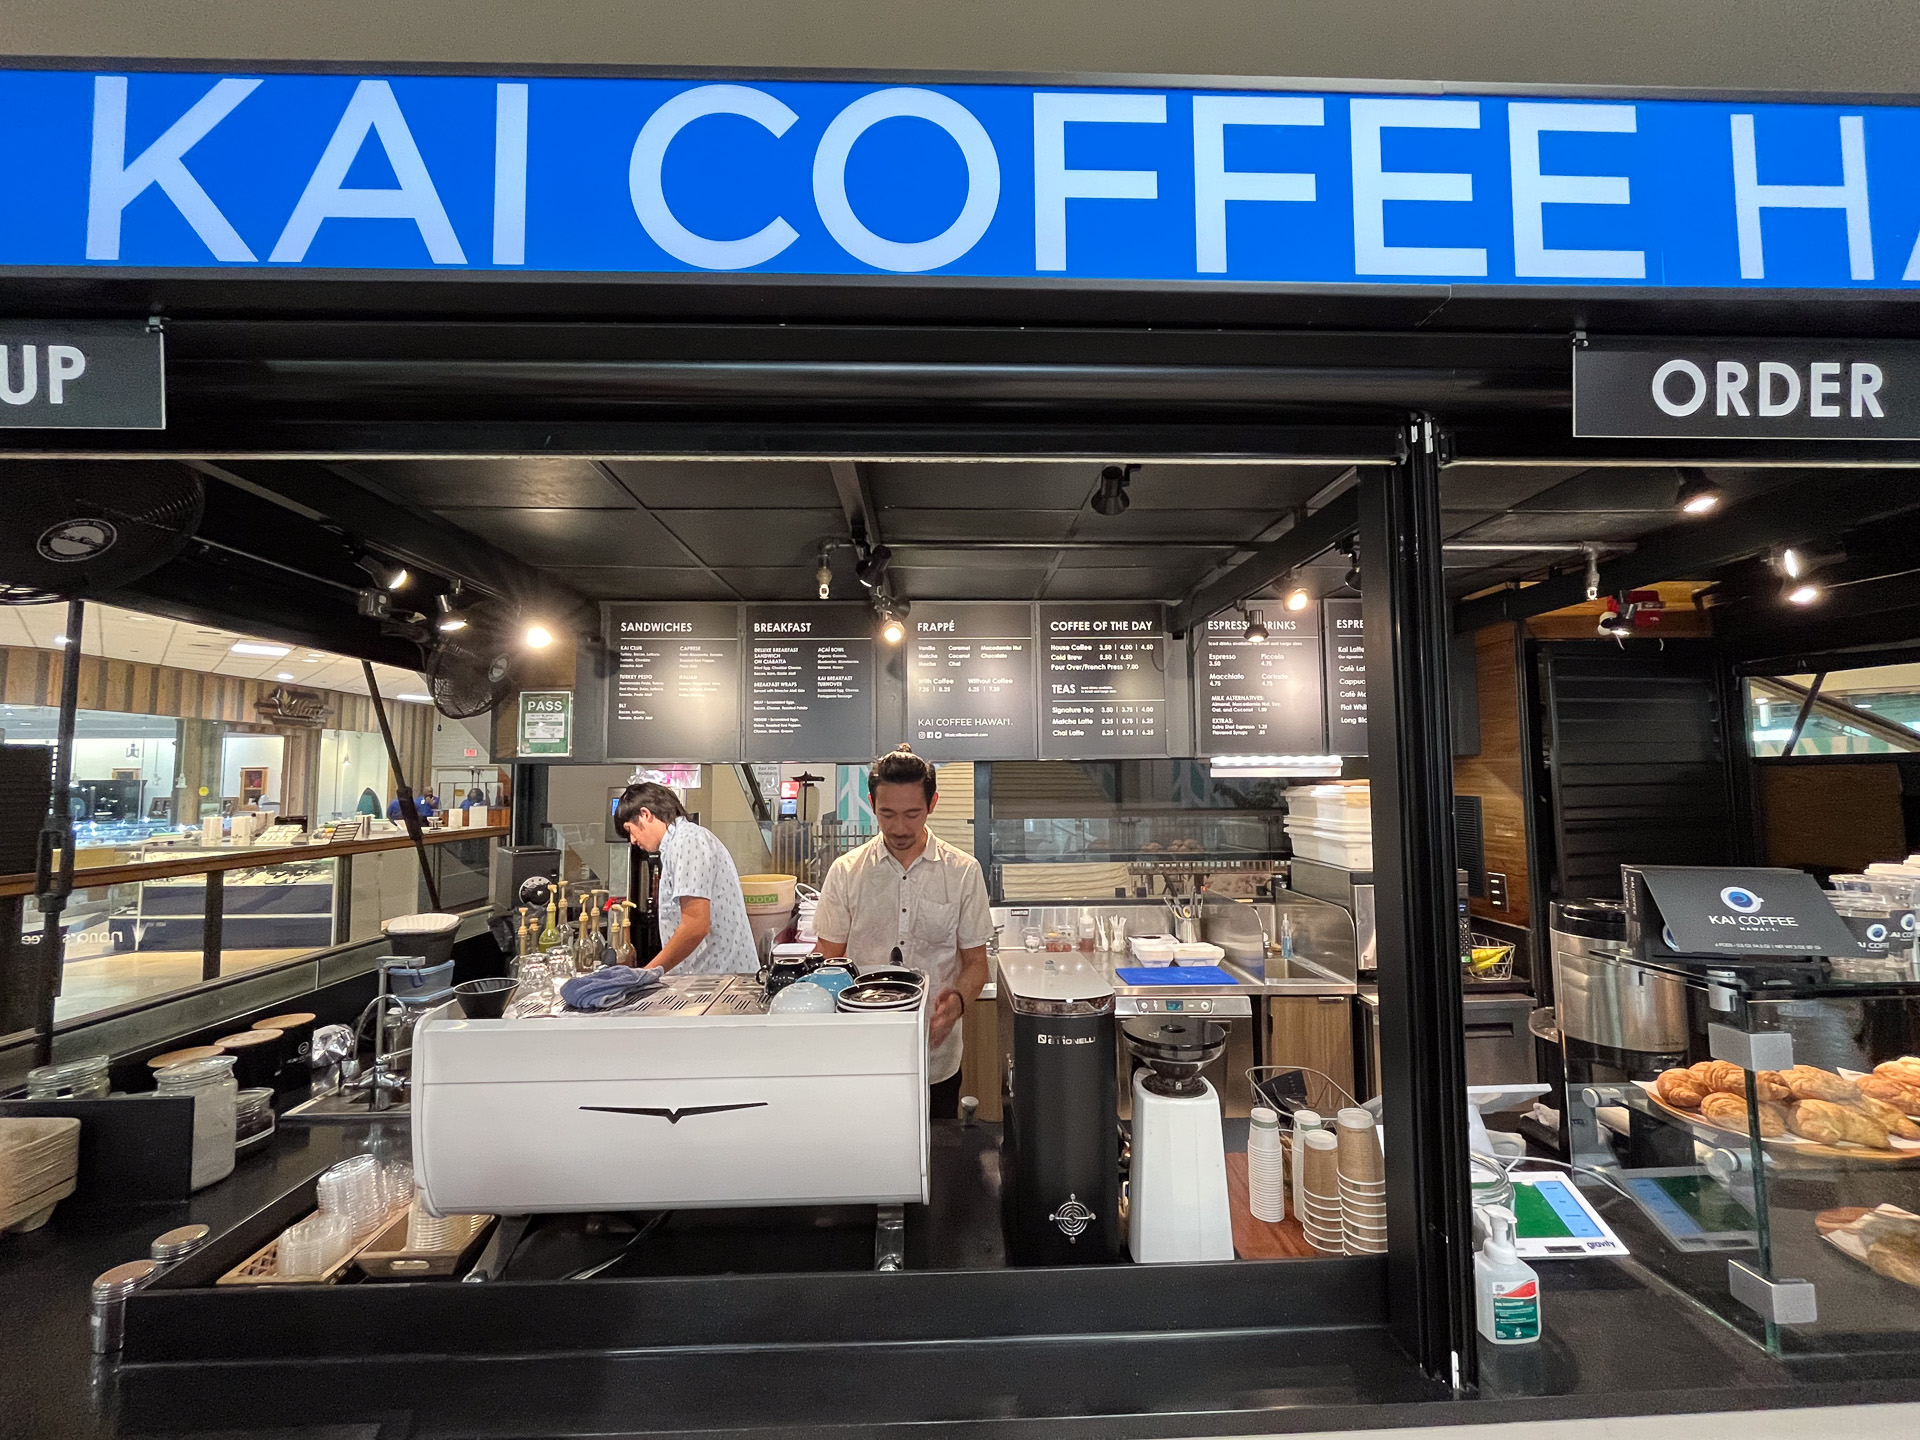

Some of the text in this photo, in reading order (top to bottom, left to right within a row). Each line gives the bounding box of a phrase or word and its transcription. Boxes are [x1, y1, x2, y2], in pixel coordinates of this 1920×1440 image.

[86, 75, 1920, 281] KAI COFFEE H
[0, 344, 86, 405] UP
[1651, 359, 1885, 420] ORDER
[620, 622, 692, 632] SANDWICHES
[754, 623, 811, 632] BREAKFAST
[917, 620, 955, 632] FRAPPÉ
[1050, 621, 1152, 631] COFFEE OF THE DAY
[1052, 685, 1076, 694] TEAS
[528, 701, 562, 711] PASS
[1708, 915, 1799, 926] KAI COFFEE
[1587, 1241, 1615, 1249] gravity
